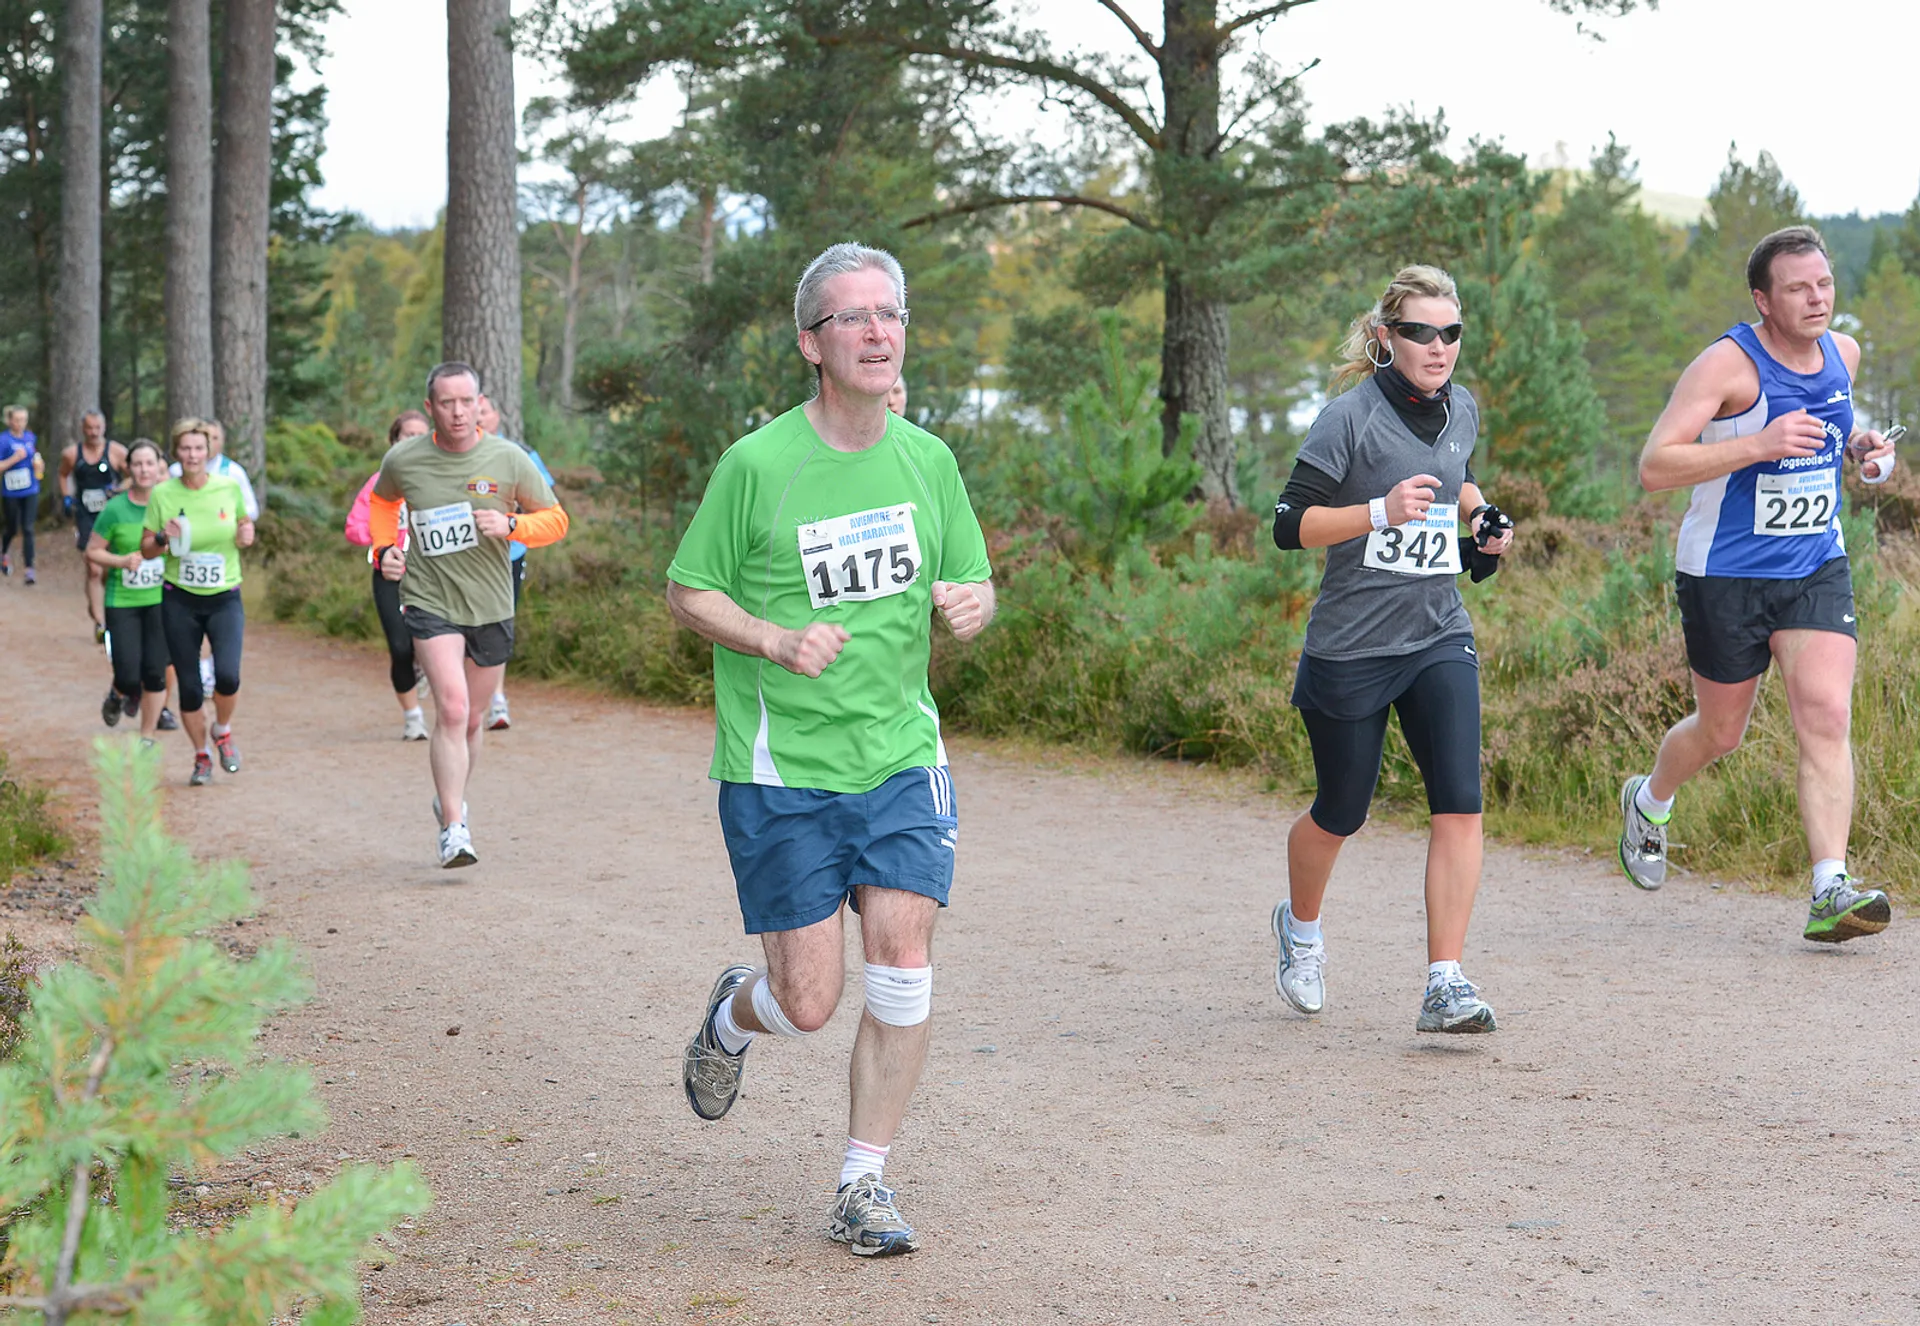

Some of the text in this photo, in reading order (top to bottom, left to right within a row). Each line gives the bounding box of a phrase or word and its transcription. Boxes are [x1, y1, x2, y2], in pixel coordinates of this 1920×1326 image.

[849, 510, 892, 530] AVIEMORE
[1765, 494, 1830, 529] 222
[420, 523, 474, 552] 1042
[837, 522, 906, 548] HALF MARATHON
[1376, 527, 1450, 569] 342
[127, 569, 163, 586] 265
[184, 565, 221, 584] 535
[812, 543, 915, 599] 1175
